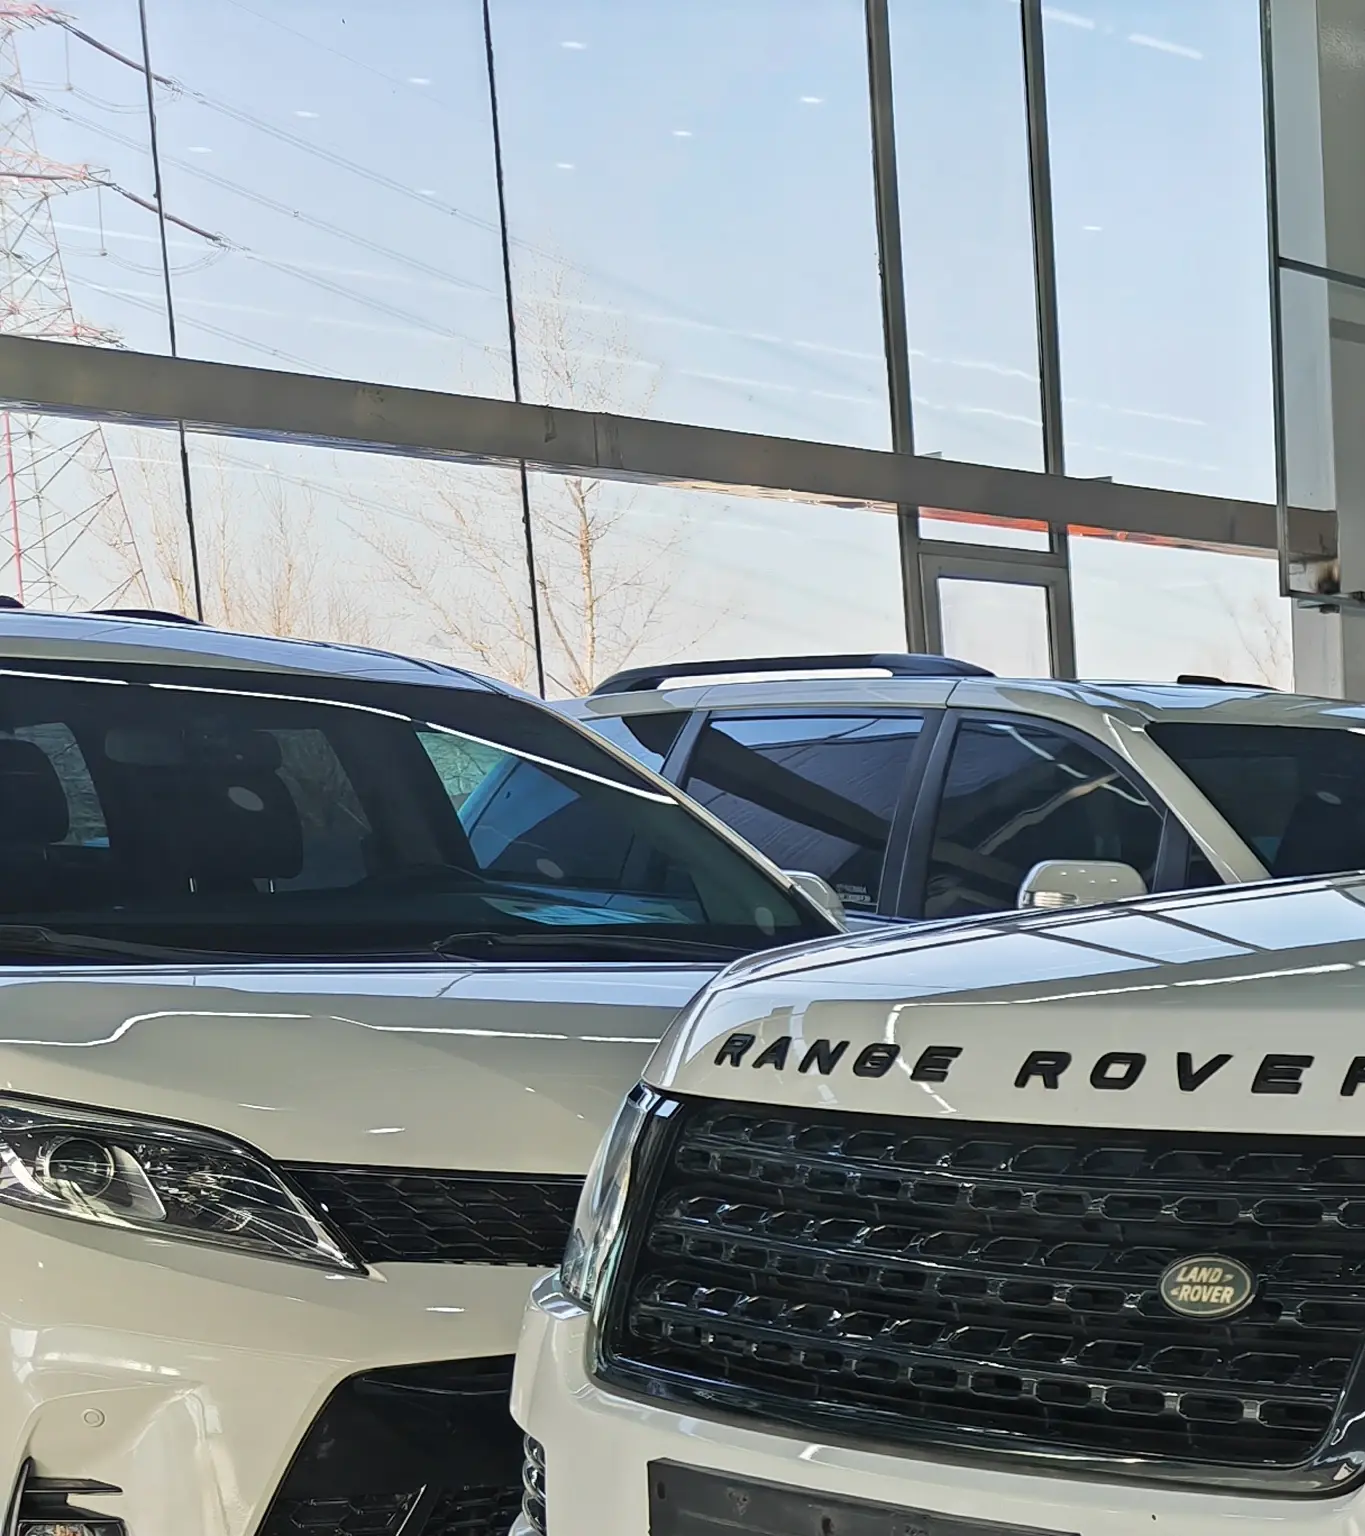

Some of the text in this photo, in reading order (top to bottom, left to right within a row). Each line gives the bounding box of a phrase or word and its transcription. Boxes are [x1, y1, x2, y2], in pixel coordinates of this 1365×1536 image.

[713, 1032, 964, 1083] RANGE
[1175, 1266, 1224, 1283] LAND
[1178, 1284, 1235, 1304] ROVER
